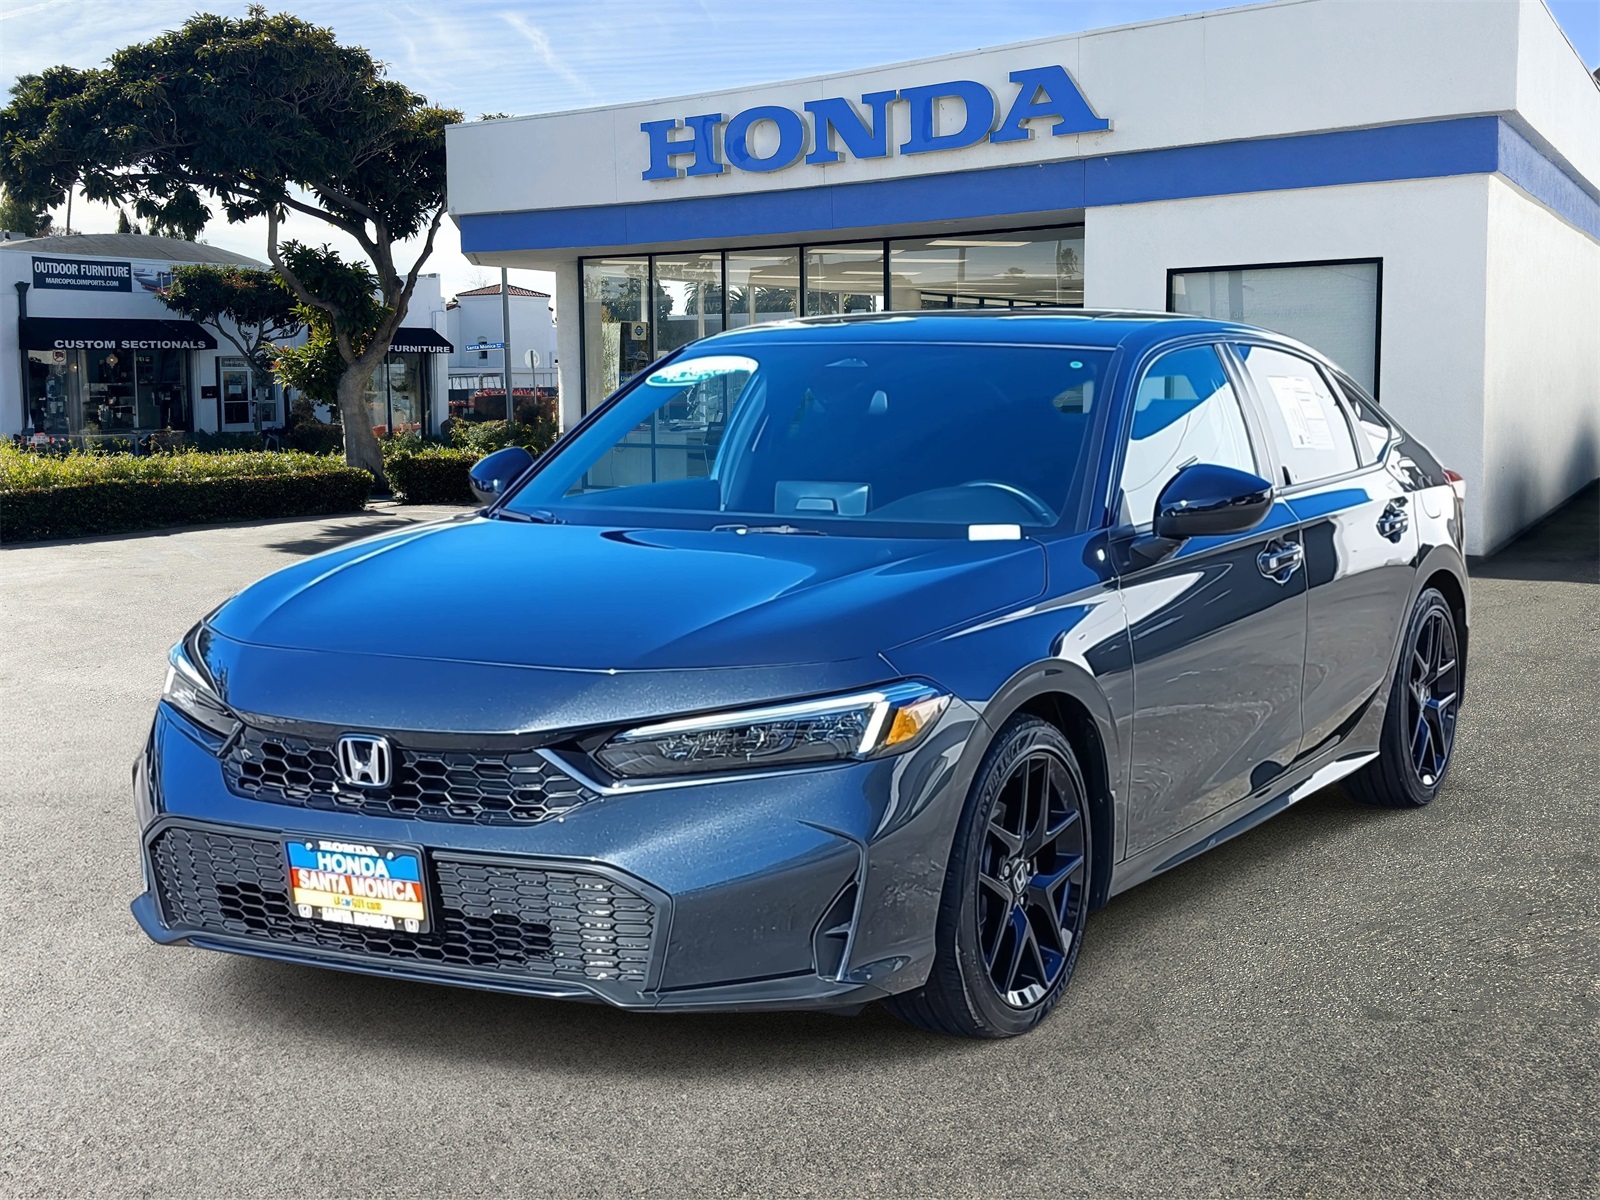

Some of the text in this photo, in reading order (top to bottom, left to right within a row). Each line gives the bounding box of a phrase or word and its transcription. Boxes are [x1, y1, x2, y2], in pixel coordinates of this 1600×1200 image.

[640, 65, 1112, 182] HONDA
[34, 261, 130, 278] OUTDOOR FURNITURE
[45, 277, 119, 287] MARCOPOLOIMPORTS.COM
[54, 340, 206, 349] CUSTOM SECTIONALS
[388, 344, 450, 353] FURNITURE
[316, 851, 391, 879] HONDA
[298, 869, 418, 902] SANTA MONICA
